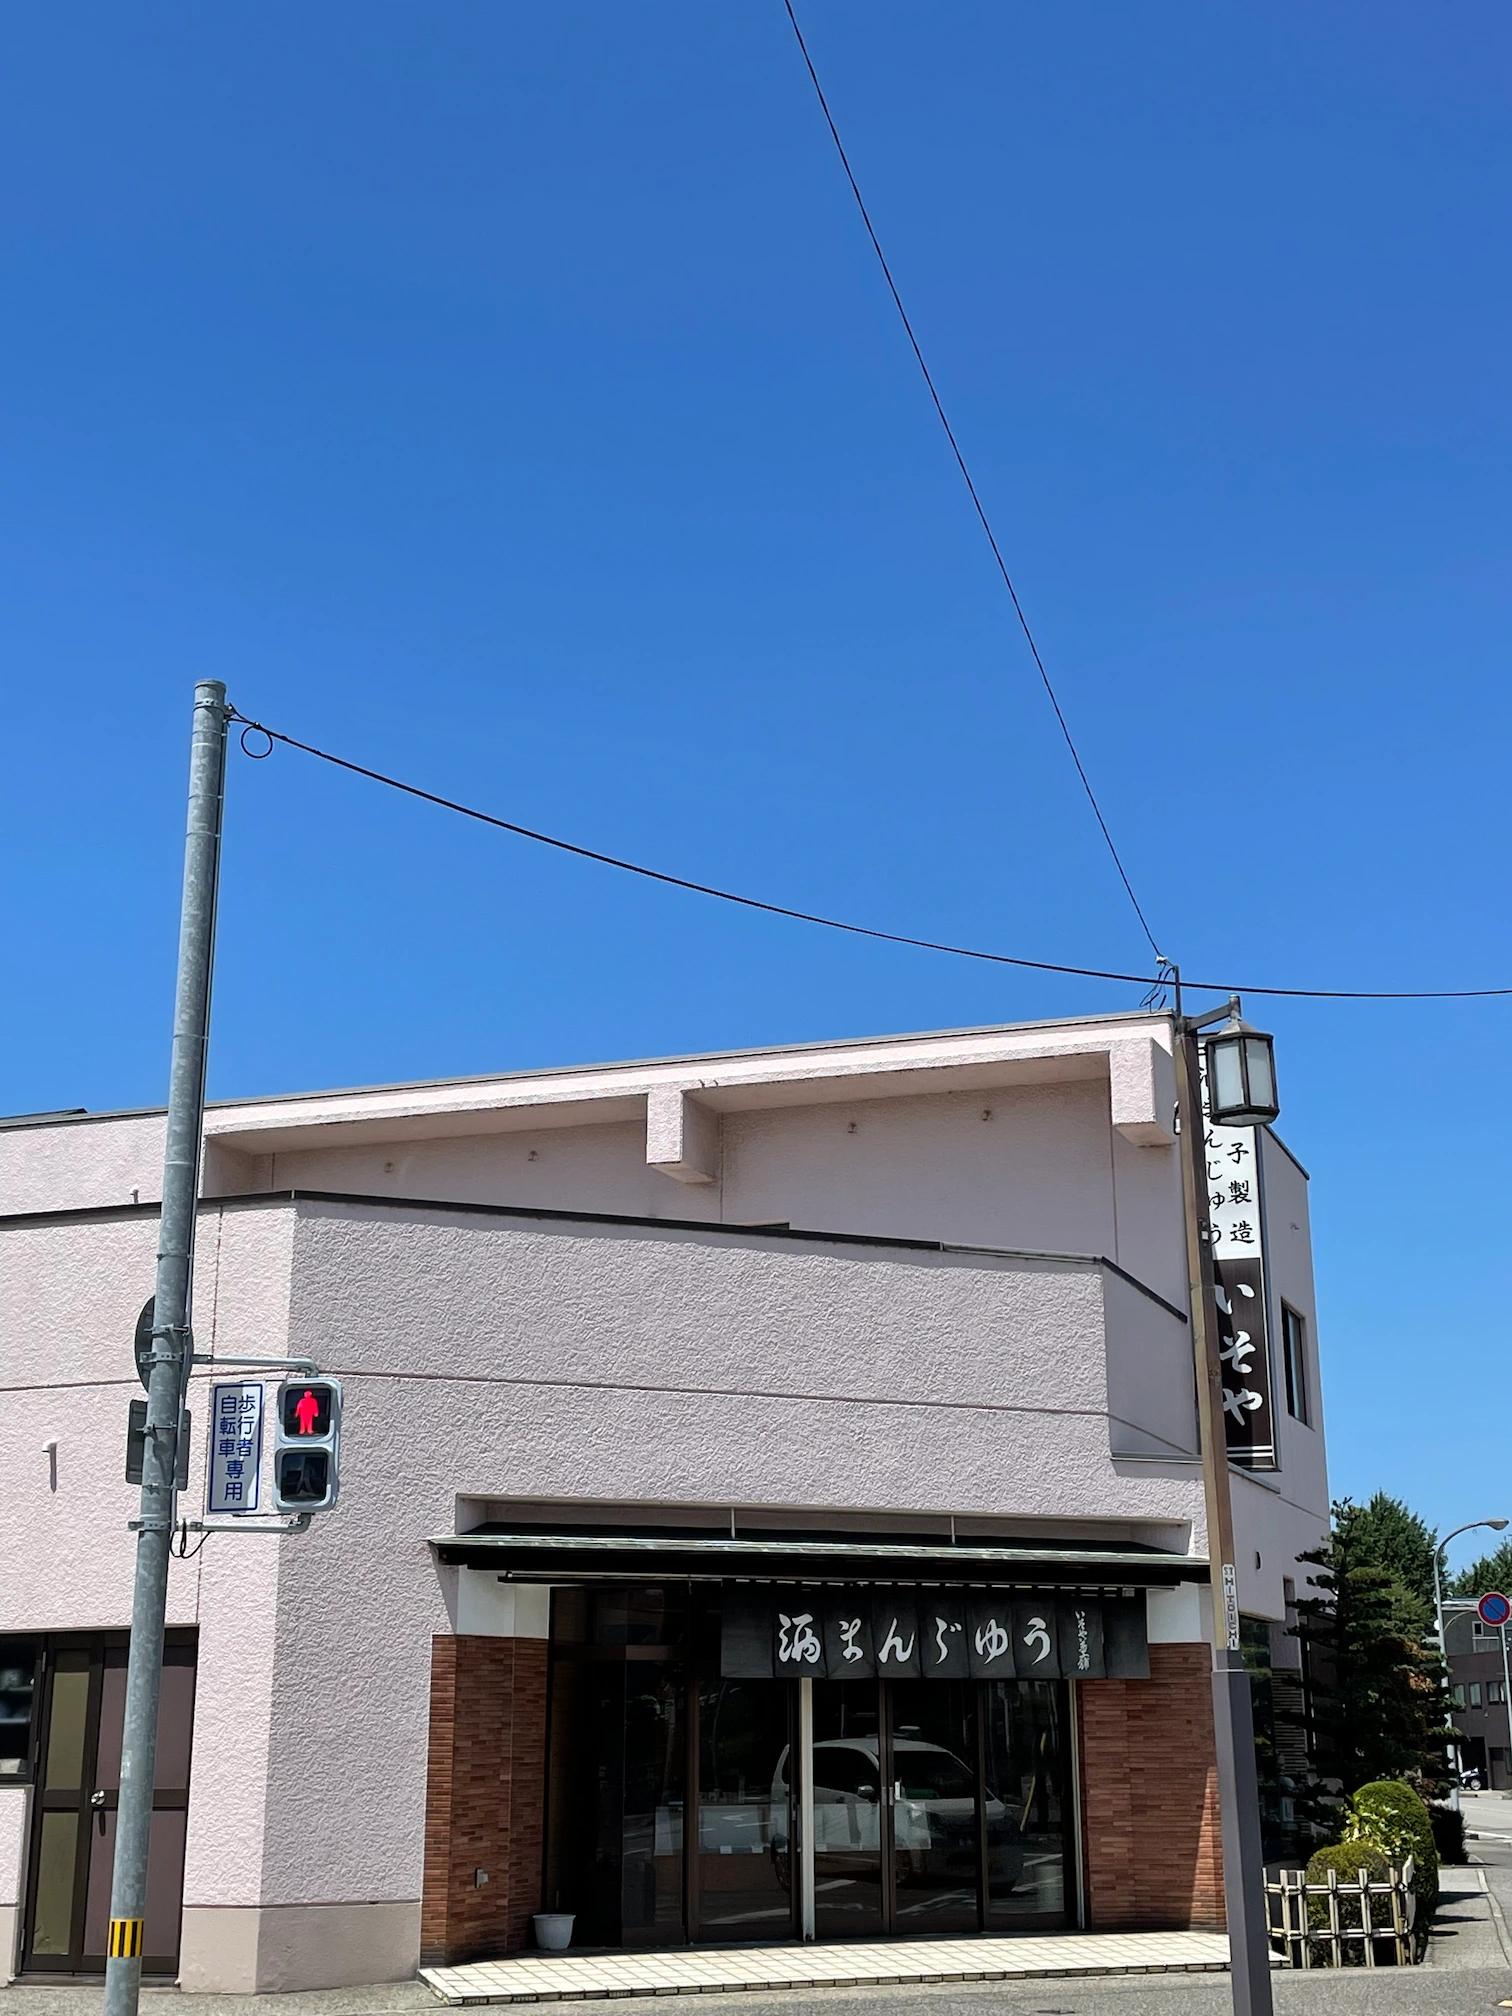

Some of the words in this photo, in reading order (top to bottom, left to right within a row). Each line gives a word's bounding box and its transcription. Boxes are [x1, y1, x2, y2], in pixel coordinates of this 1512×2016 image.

[1214, 1283, 1263, 1426] いそや
[218, 1394, 237, 1457] 自転車
[236, 1394, 256, 1457] 歩行者
[224, 1460, 245, 1501] 専用
[1225, 1577, 1238, 1648] HITOICHI
